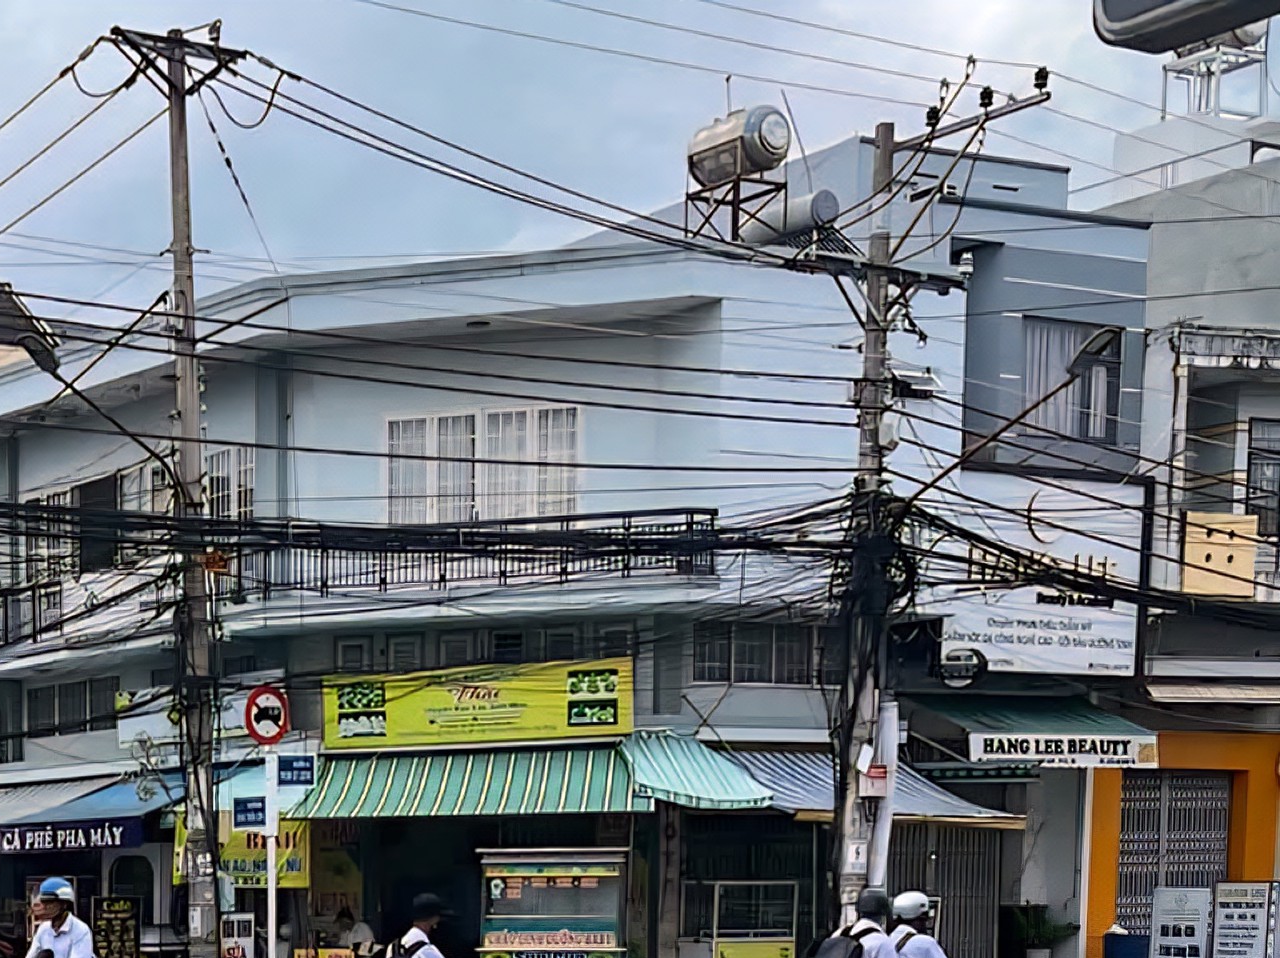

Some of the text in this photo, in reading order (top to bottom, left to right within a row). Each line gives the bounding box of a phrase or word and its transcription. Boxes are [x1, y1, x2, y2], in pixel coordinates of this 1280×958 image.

[983, 737, 1131, 756] HANG LEE BEAUTY
[25, 825, 54, 849] PHÊ
[57, 829, 86, 848] PHA
[90, 822, 123, 846] MÁY
